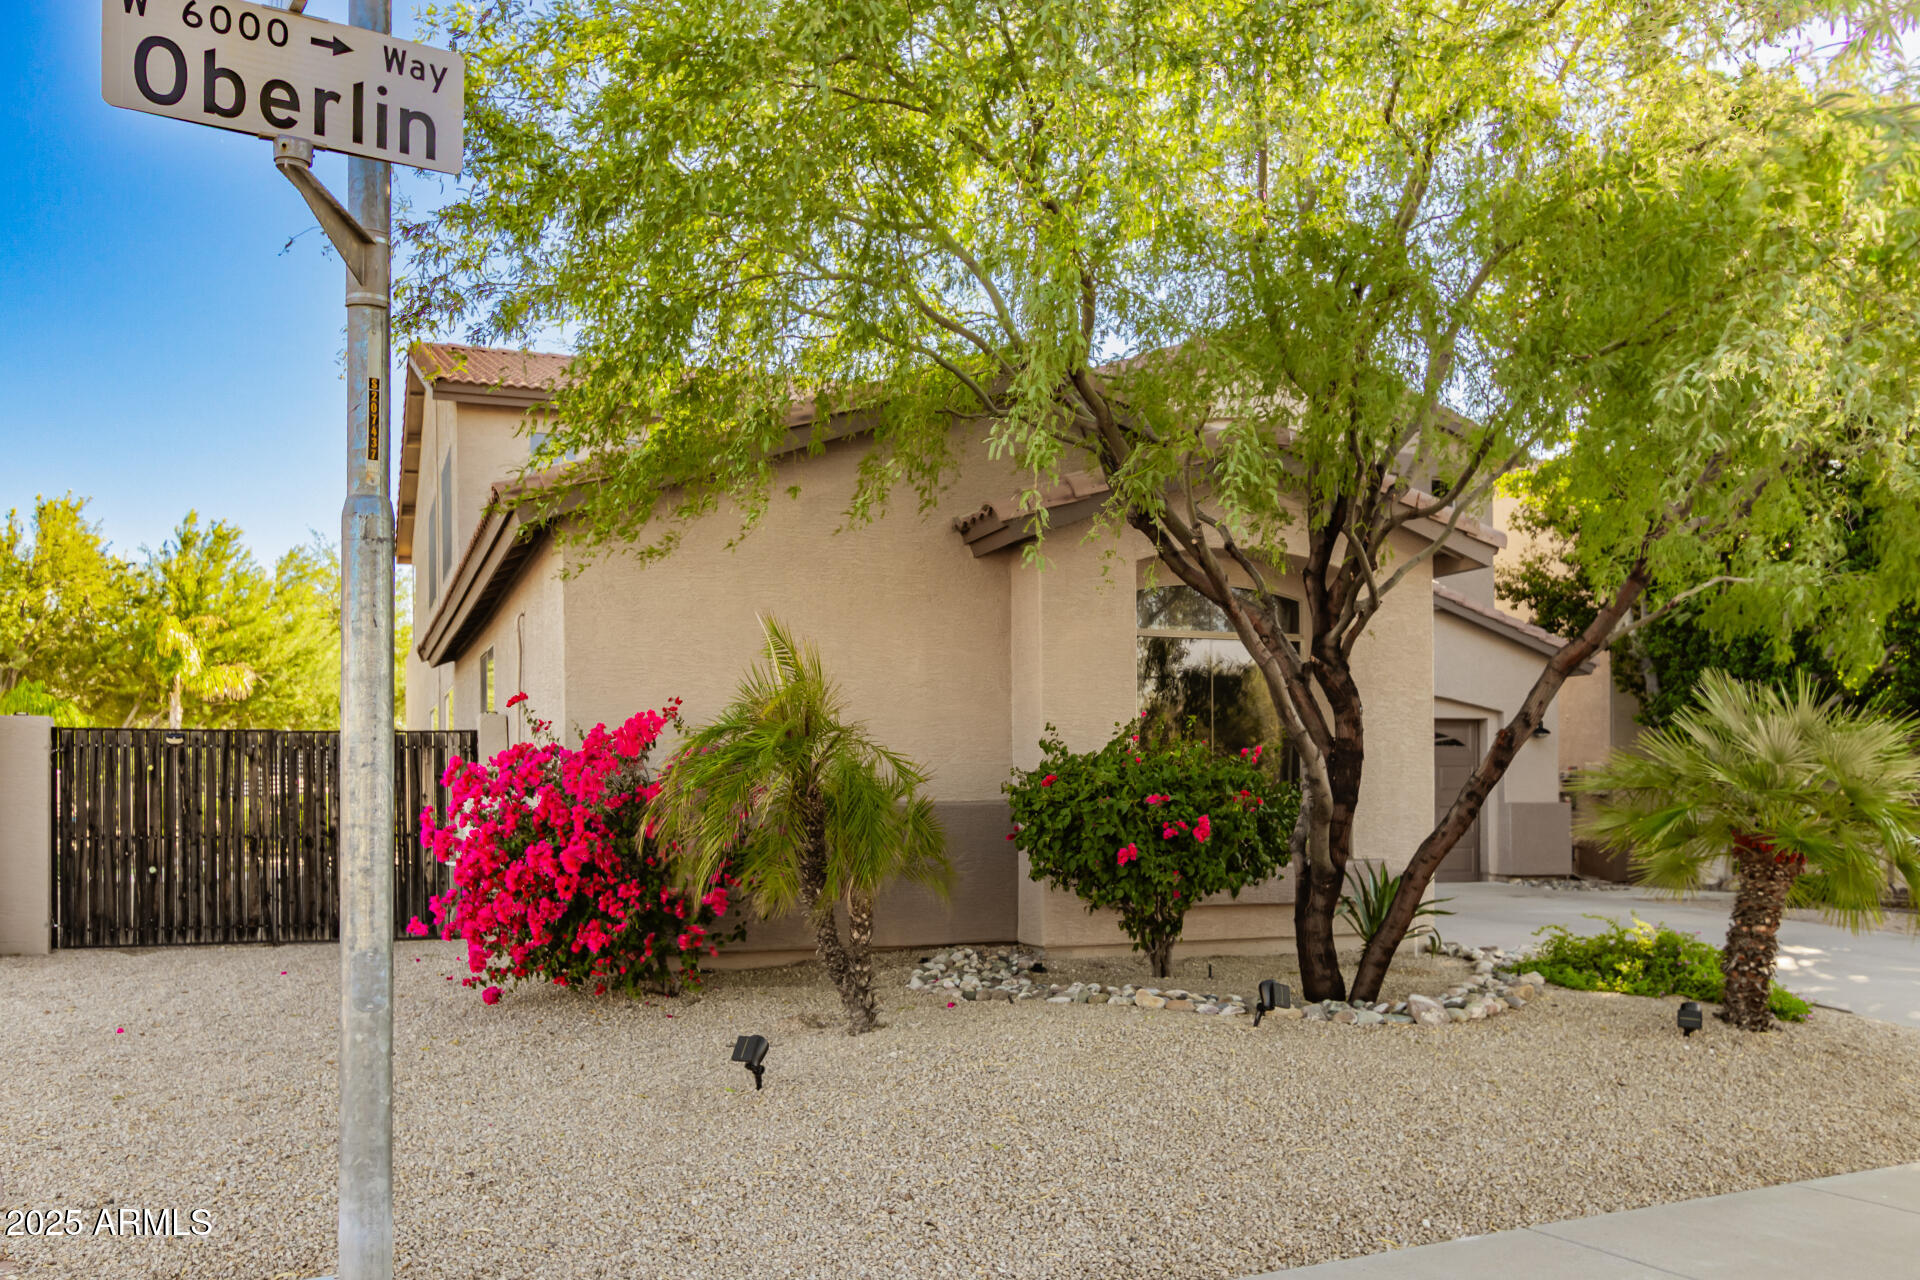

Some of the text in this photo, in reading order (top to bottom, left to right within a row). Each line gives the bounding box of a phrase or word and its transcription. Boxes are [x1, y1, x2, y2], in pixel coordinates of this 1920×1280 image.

[134, 35, 437, 161] Oberlin
[181, 0, 289, 48] 6000
[383, 45, 448, 94] Way
